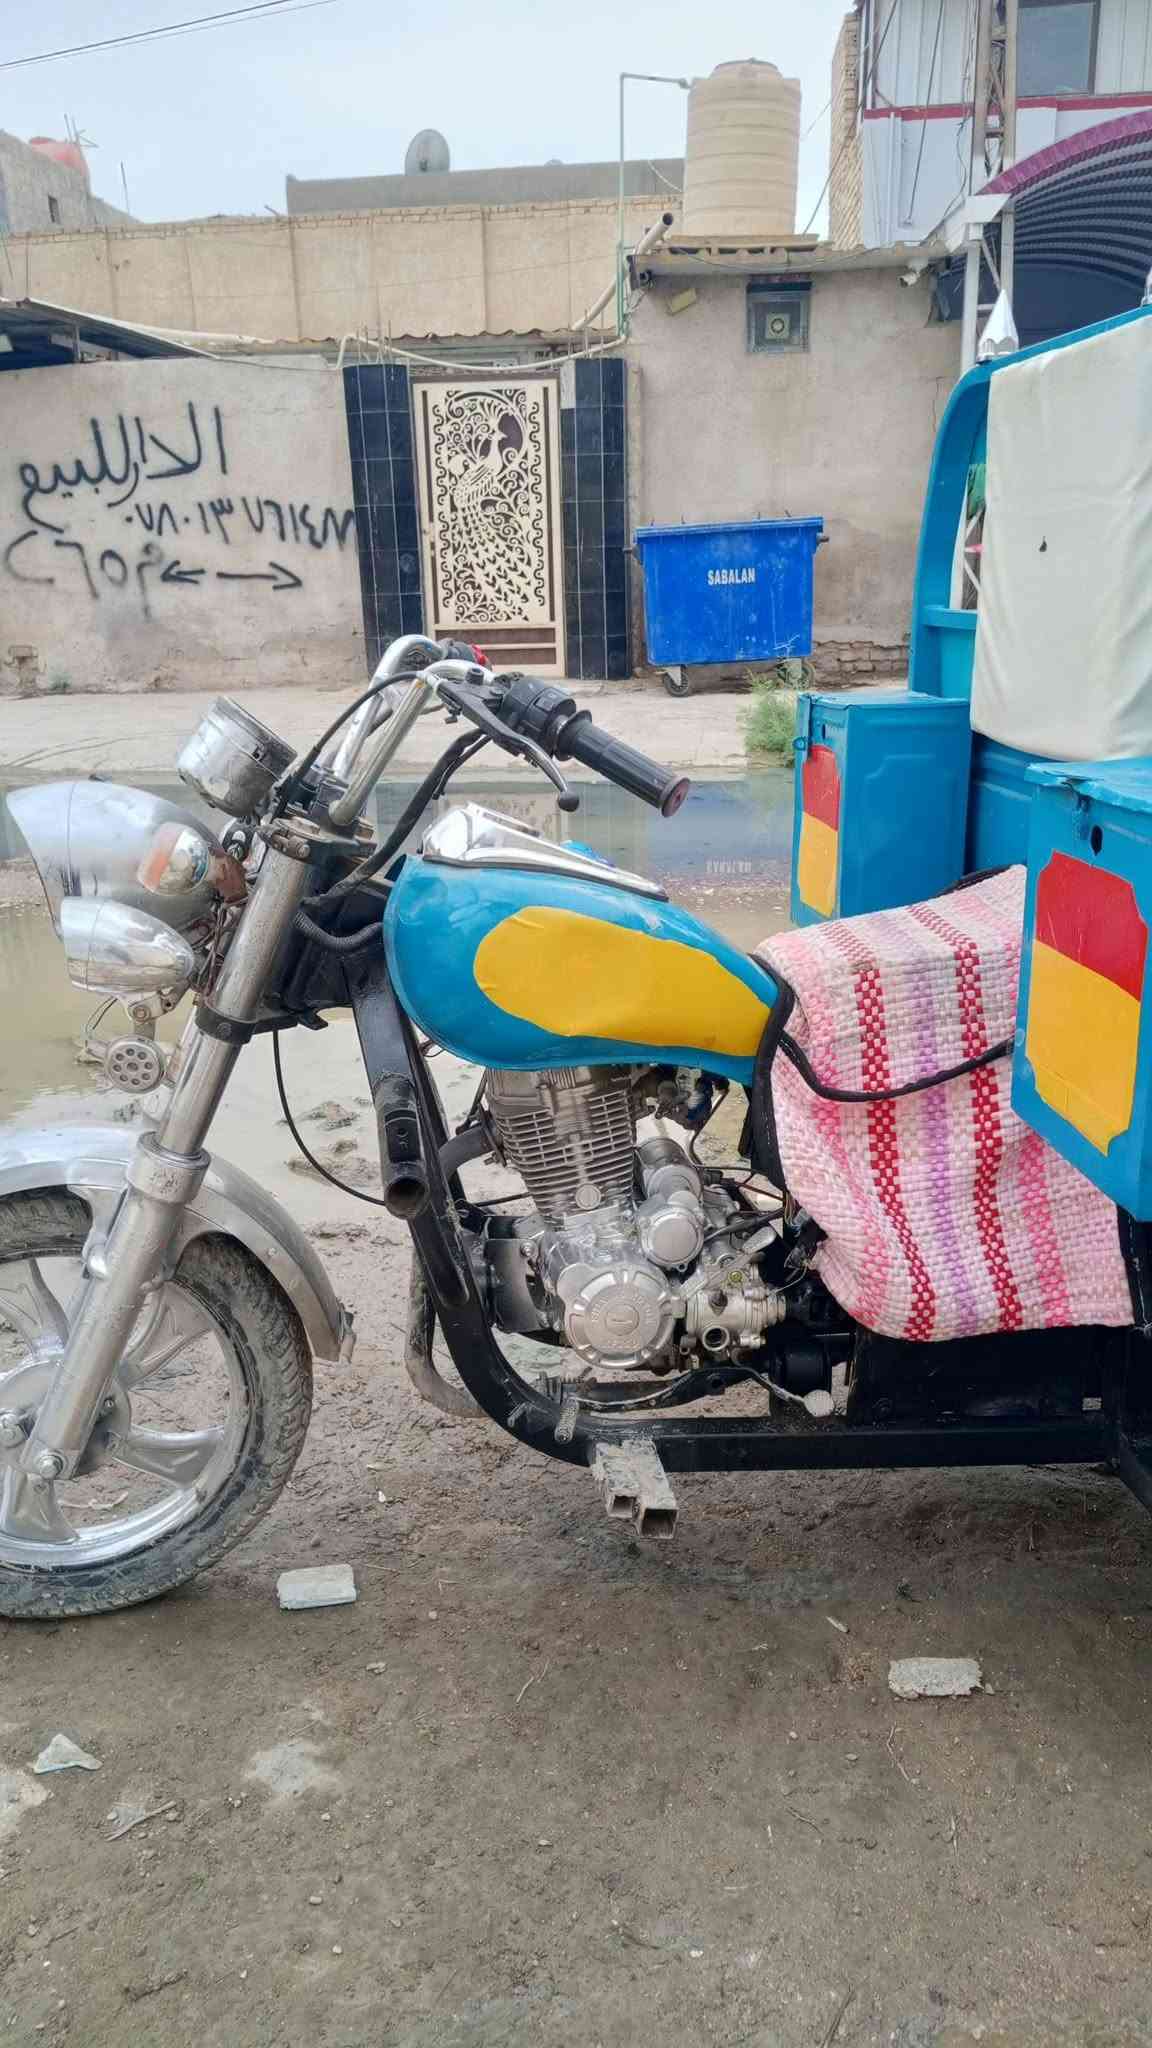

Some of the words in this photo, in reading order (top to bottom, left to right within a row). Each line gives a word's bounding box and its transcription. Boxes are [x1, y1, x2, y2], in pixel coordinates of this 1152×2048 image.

[19, 413, 132, 534] للبيع
[107, 401, 228, 507] الدار
[707, 567, 756, 586] SABALAN
